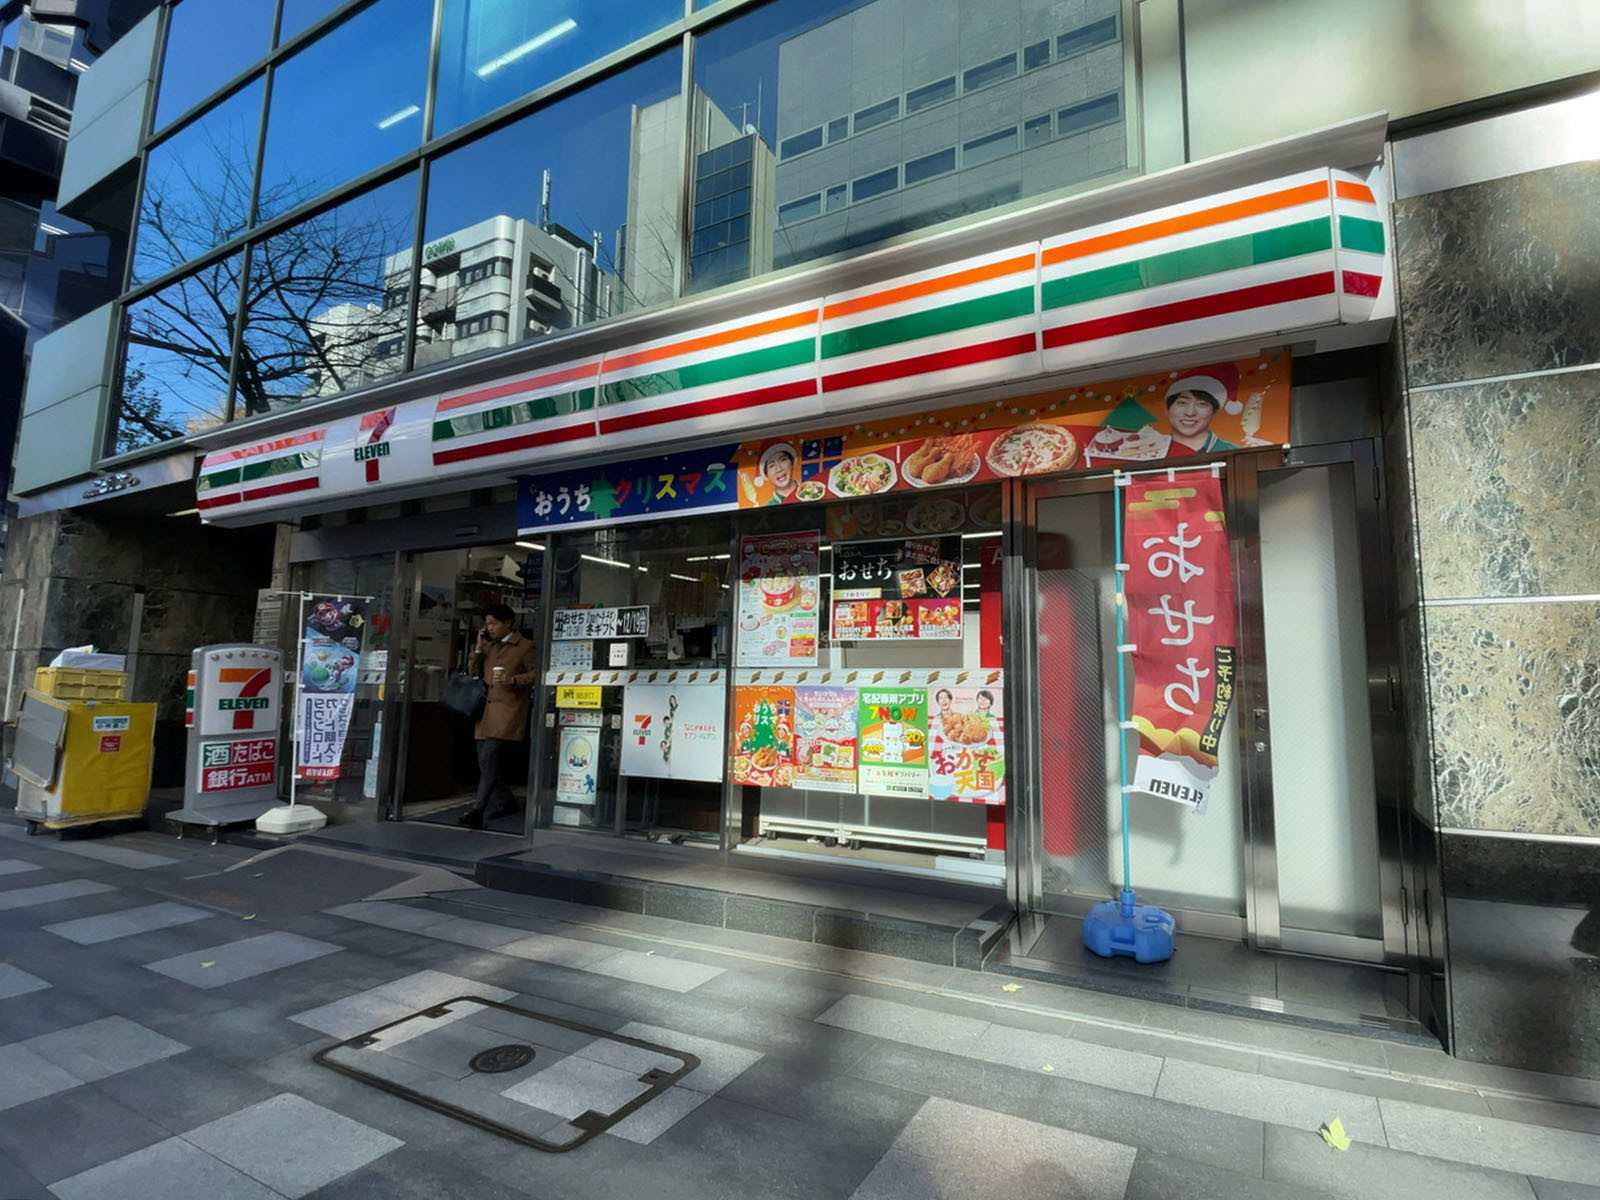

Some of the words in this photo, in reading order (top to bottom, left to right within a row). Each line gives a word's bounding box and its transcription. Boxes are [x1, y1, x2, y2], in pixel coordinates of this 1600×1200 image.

[534, 483, 592, 517] おうち
[614, 463, 727, 504] クリスマス
[838, 557, 893, 582] おせち
[563, 611, 585, 625] おせち
[585, 621, 616, 637] 冬ギフト
[219, 667, 272, 729] 7
[752, 701, 777, 714] おうち
[862, 692, 925, 705] 宅配専用アプリ
[744, 711, 788, 725] クリスマス
[867, 705, 917, 720] 7NOW
[205, 743, 230, 766] 酒
[233, 740, 274, 763] たばこ
[930, 747, 998, 775] おかず
[952, 769, 995, 794] 天国
